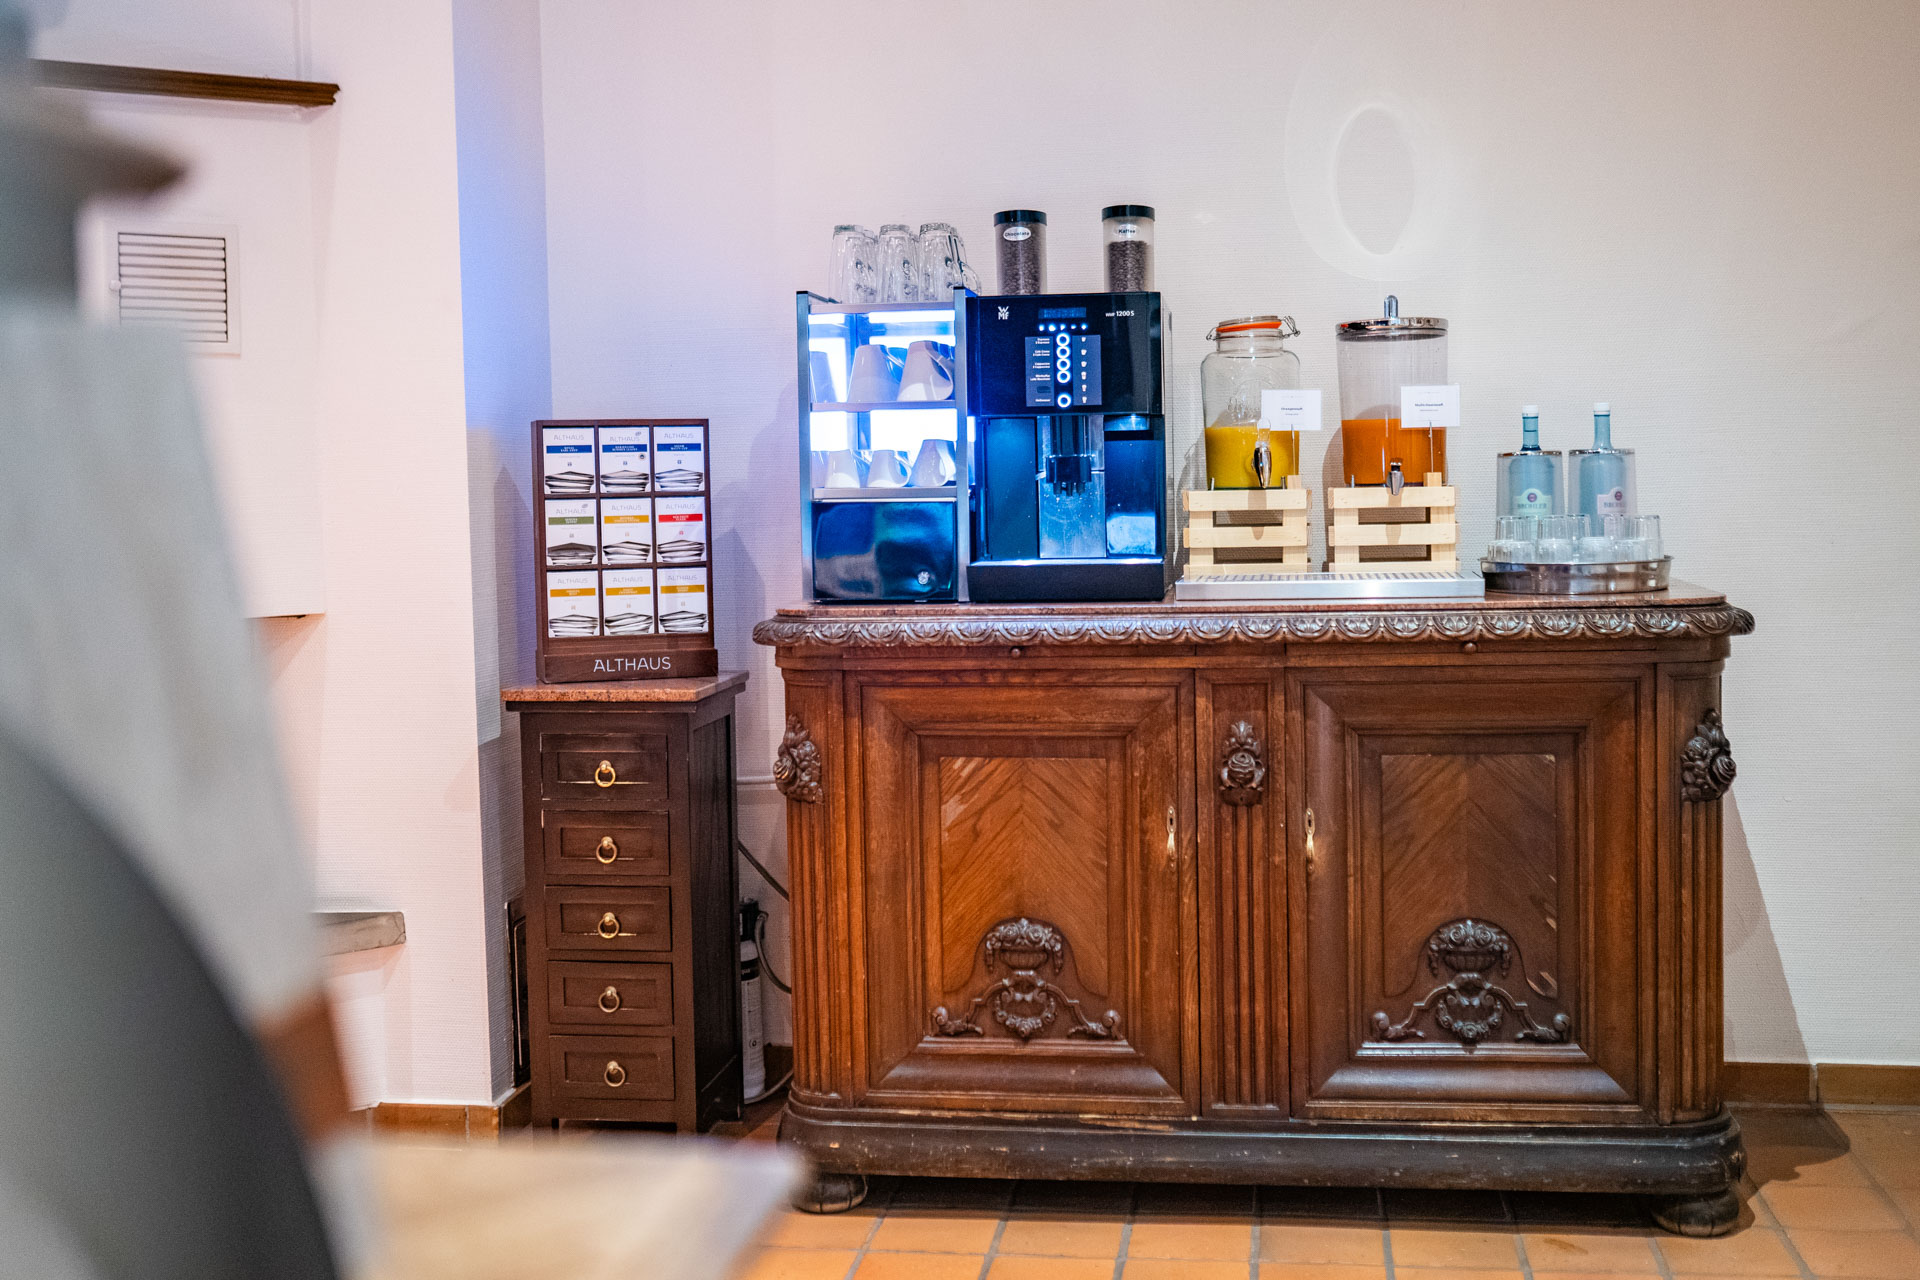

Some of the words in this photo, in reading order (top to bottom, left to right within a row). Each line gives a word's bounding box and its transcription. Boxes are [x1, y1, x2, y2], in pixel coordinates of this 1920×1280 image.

[609, 435, 641, 443] ALTHAUS
[557, 577, 588, 585] ALTHAUS
[593, 656, 672, 673] ALTHAUS
